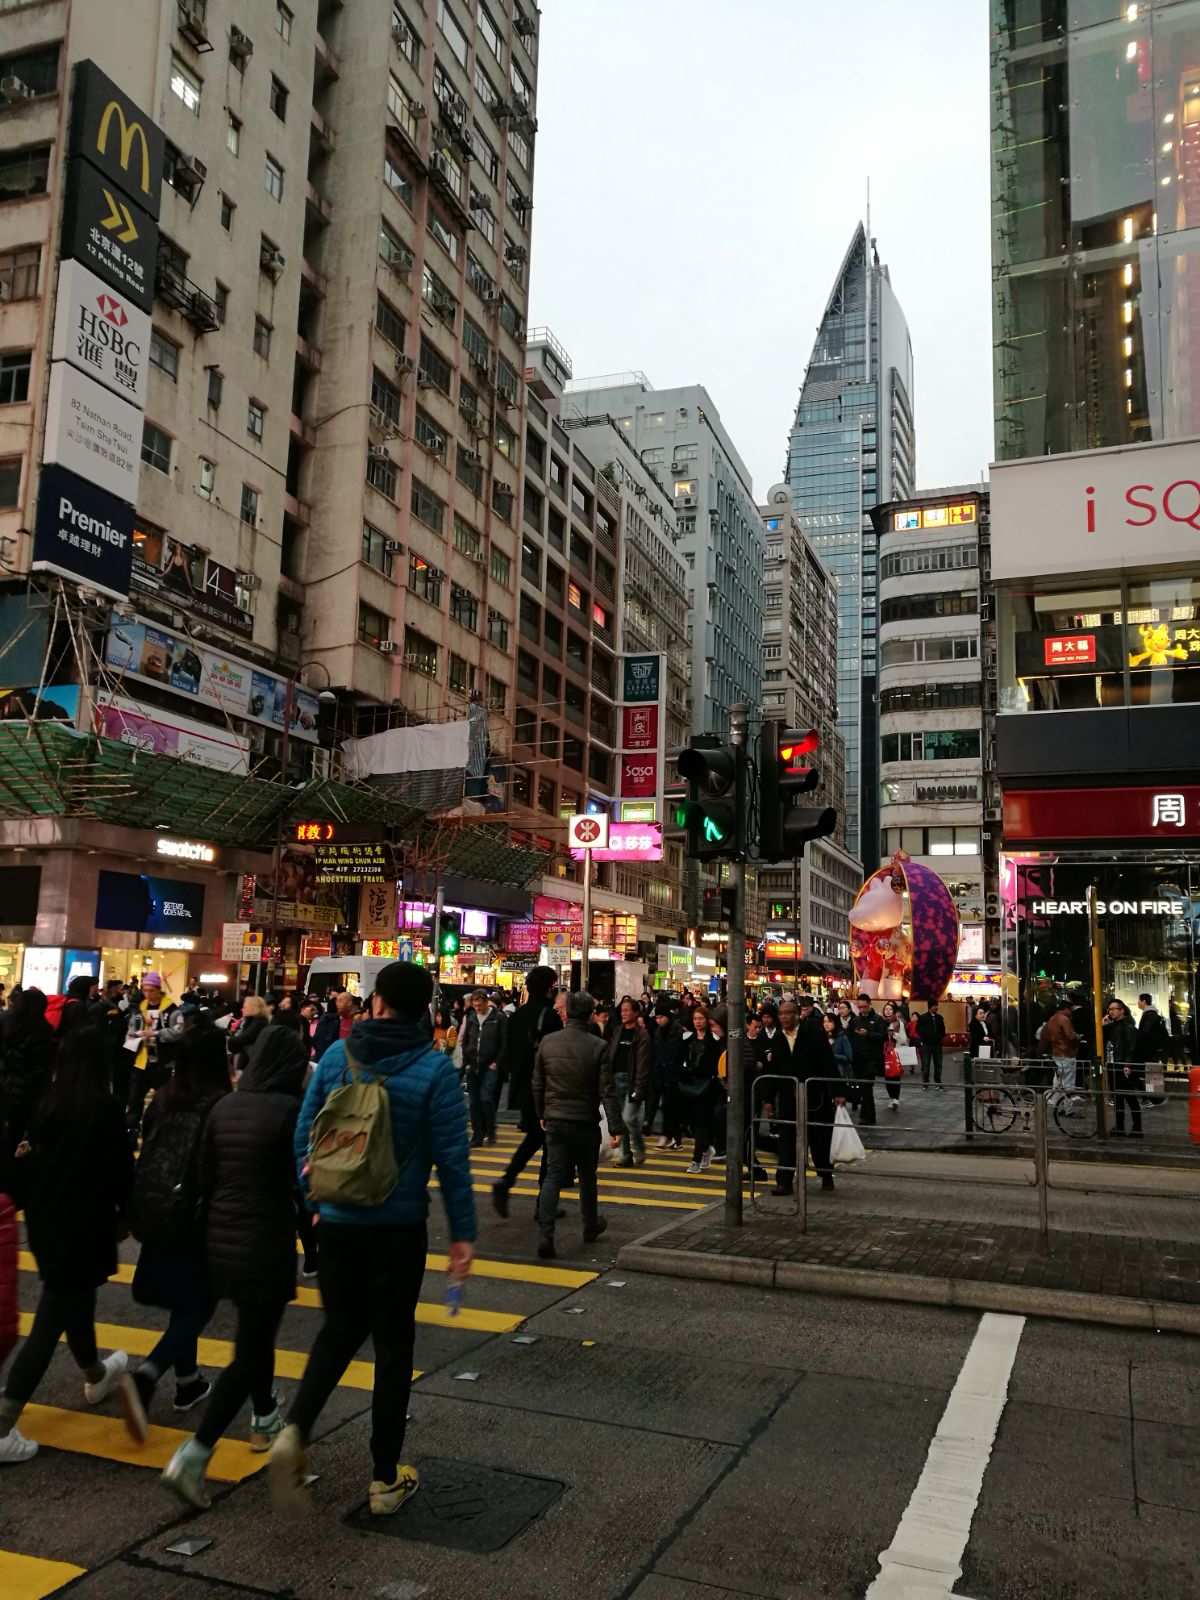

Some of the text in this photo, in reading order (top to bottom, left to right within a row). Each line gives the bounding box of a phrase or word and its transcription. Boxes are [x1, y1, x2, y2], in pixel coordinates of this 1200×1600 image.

[79, 304, 140, 367] HSBC
[59, 496, 127, 549] Premier
[1152, 794, 1186, 827] 周
[1032, 901, 1184, 915] HEARTS ON FIRE
